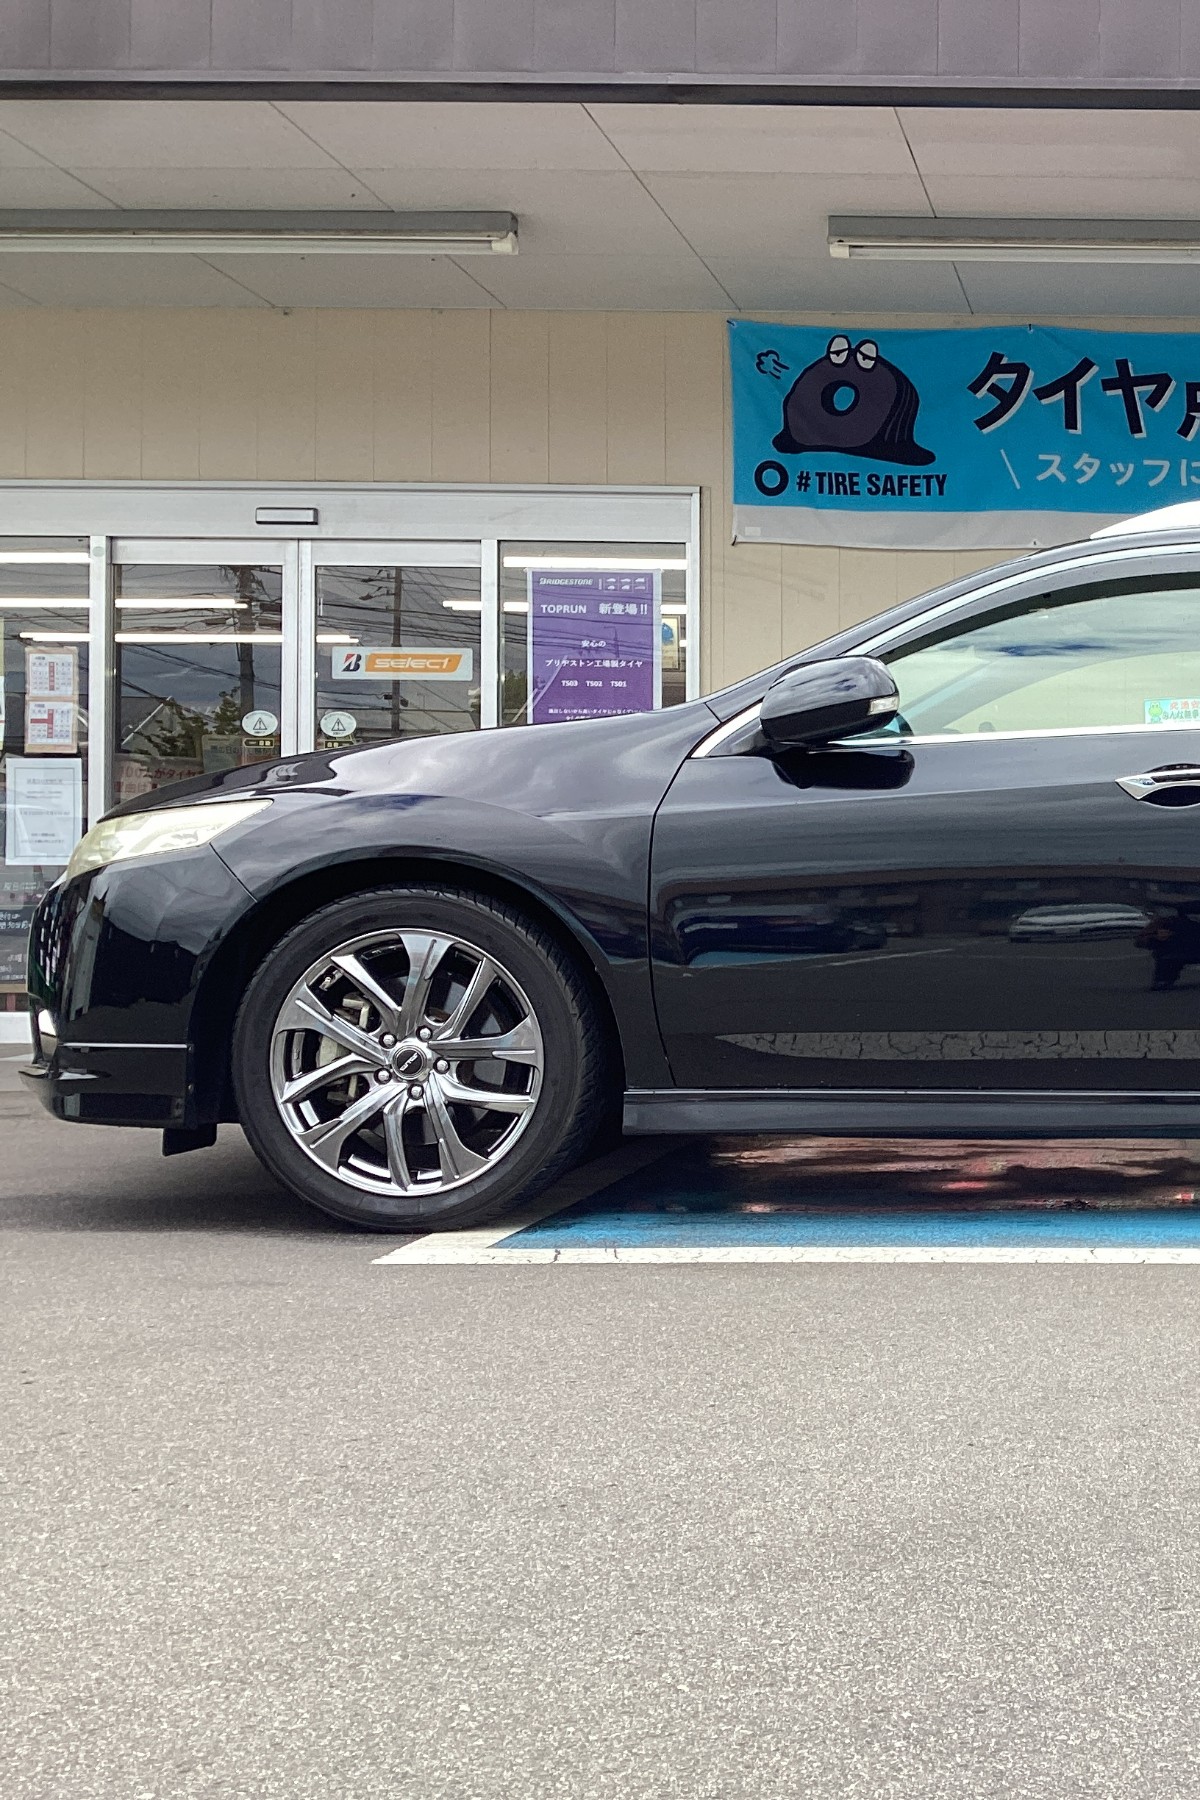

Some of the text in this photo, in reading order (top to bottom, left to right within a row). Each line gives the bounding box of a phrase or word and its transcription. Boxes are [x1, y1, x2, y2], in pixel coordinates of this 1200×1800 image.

[866, 473, 948, 497] SAFETY
[540, 604, 587, 614] TOPRUN
[581, 640, 607, 648] 安心の
